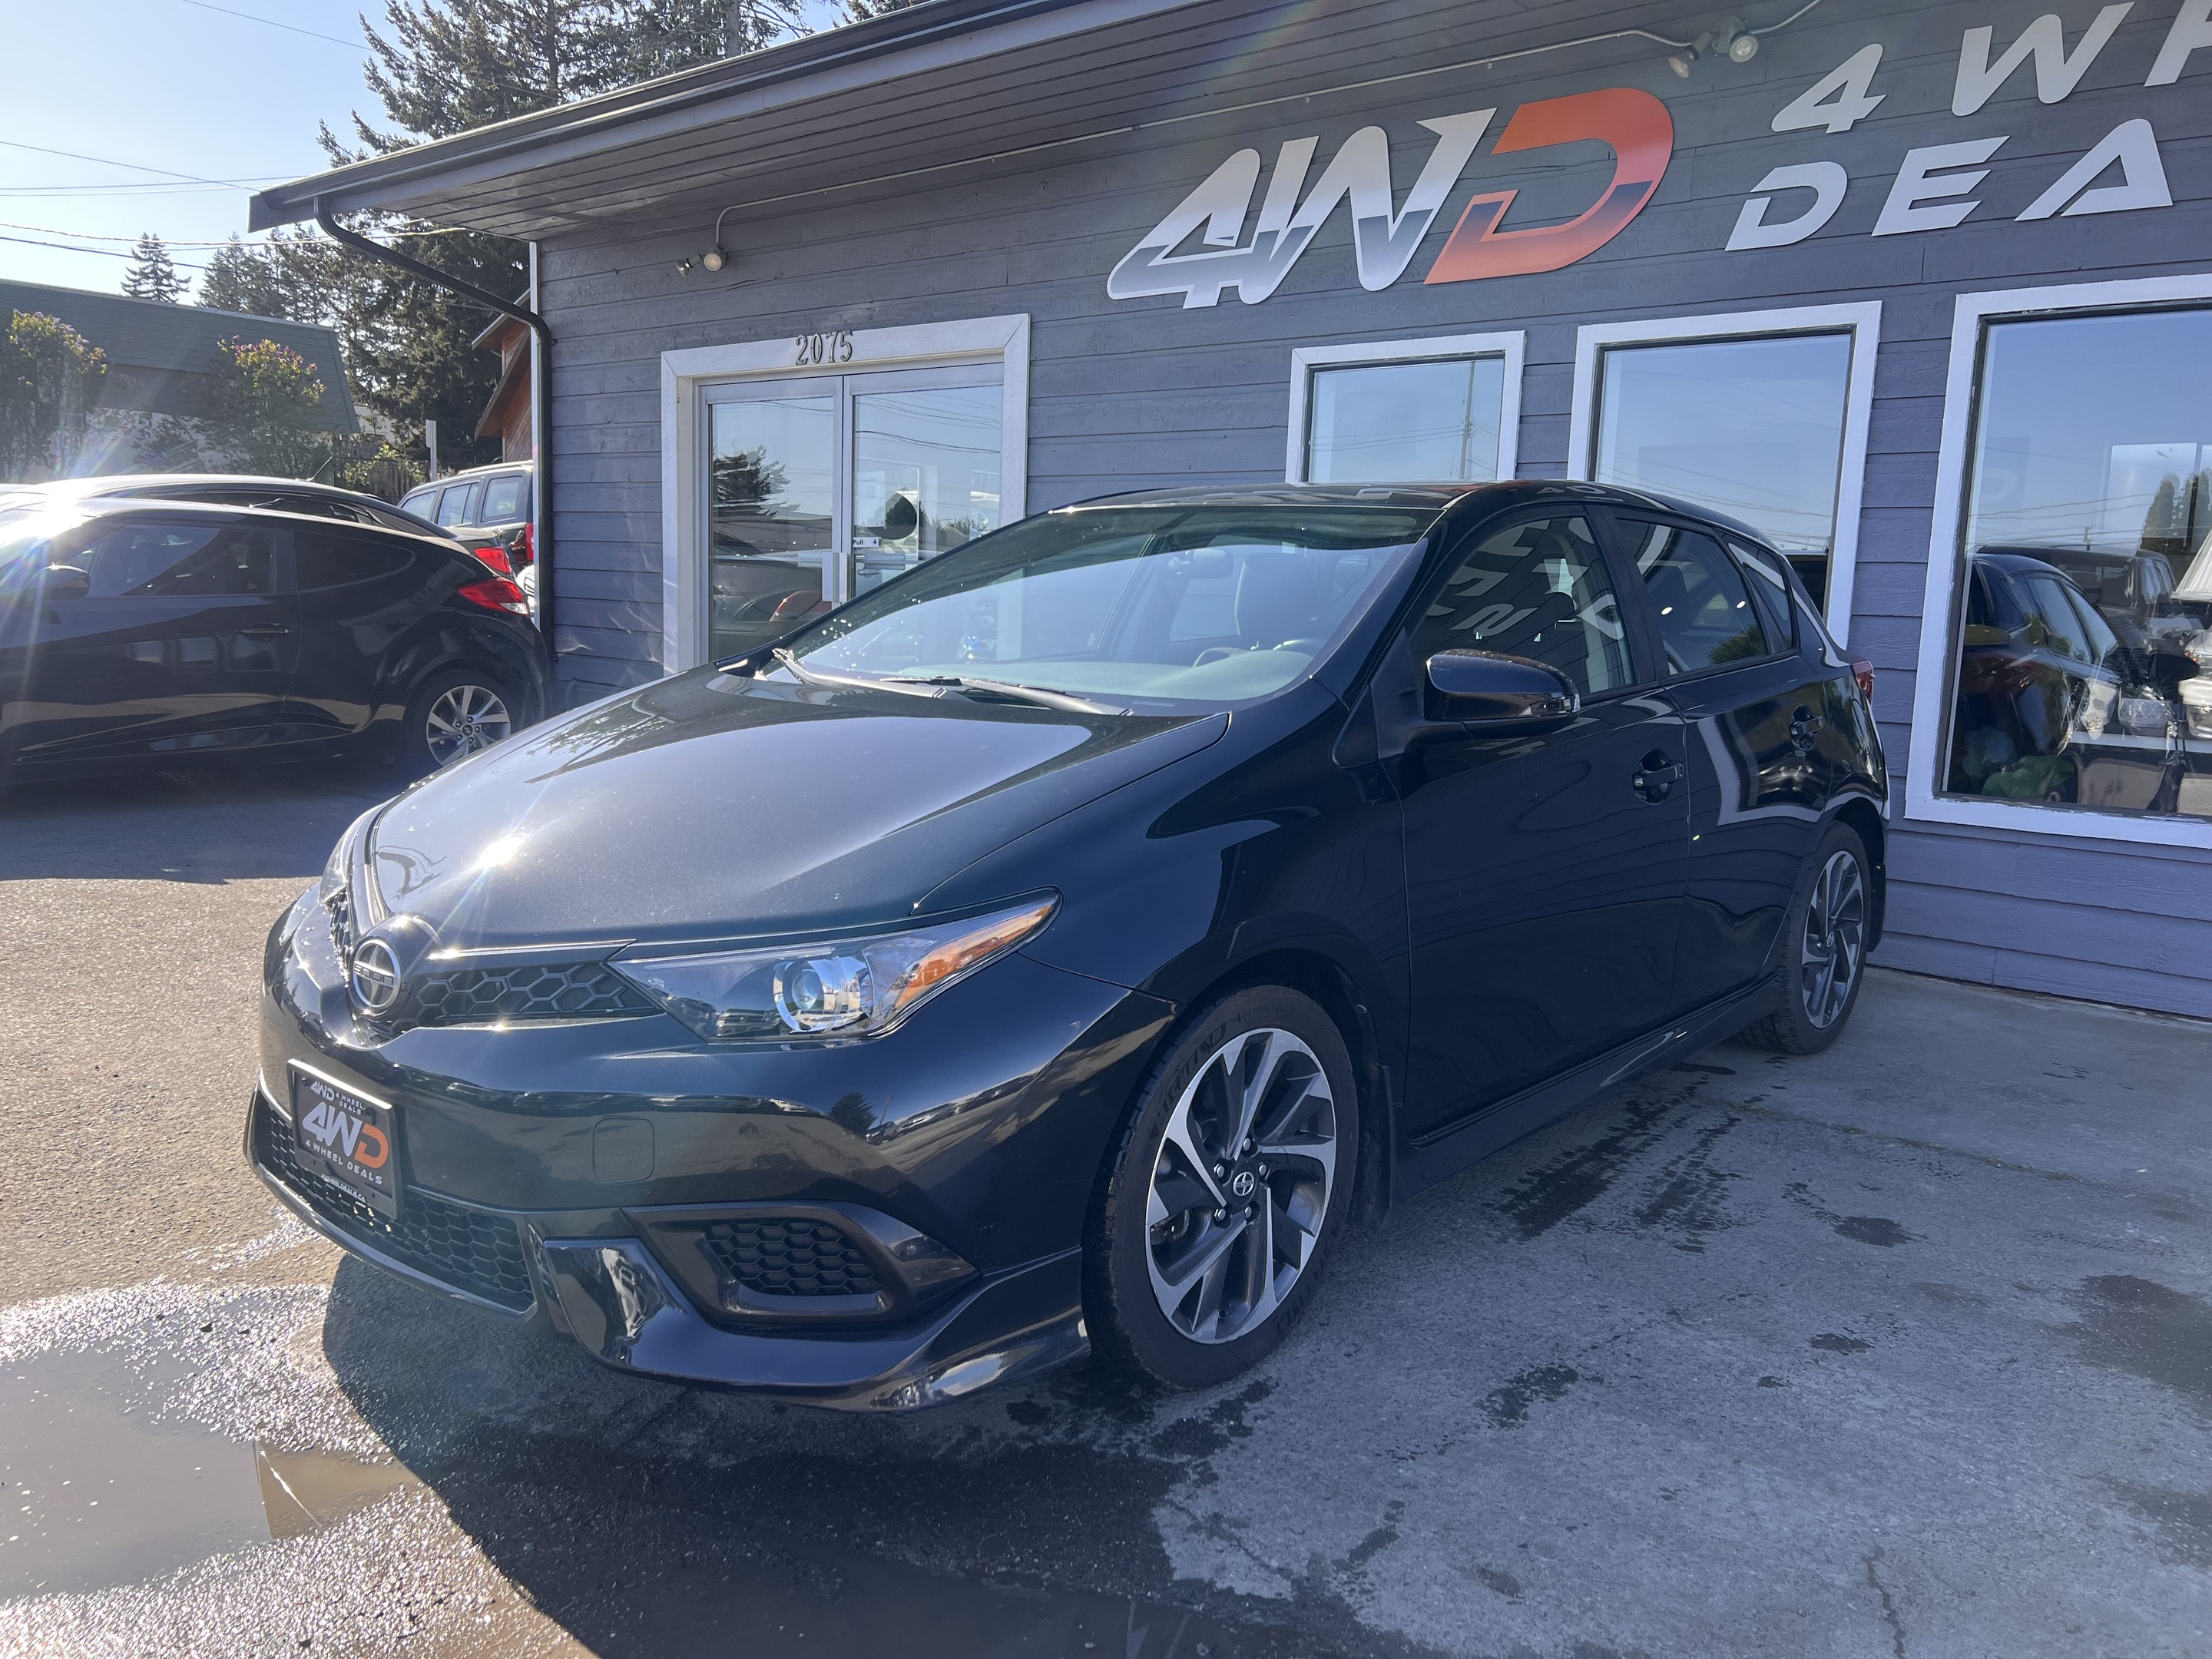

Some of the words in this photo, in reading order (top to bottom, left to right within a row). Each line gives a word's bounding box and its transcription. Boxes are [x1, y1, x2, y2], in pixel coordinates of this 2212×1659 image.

[1771, 43, 1887, 134] 4
[1107, 87, 1674, 309] 4WD
[1724, 118, 2174, 251] DEA
[795, 330, 853, 366] 2075
[302, 1101, 389, 1168] 4WD
[339, 1100, 362, 1115] DEALS
[305, 1139, 311, 1147] 4
[313, 1142, 343, 1166] WHEEL
[347, 1161, 382, 1185] DEALS
